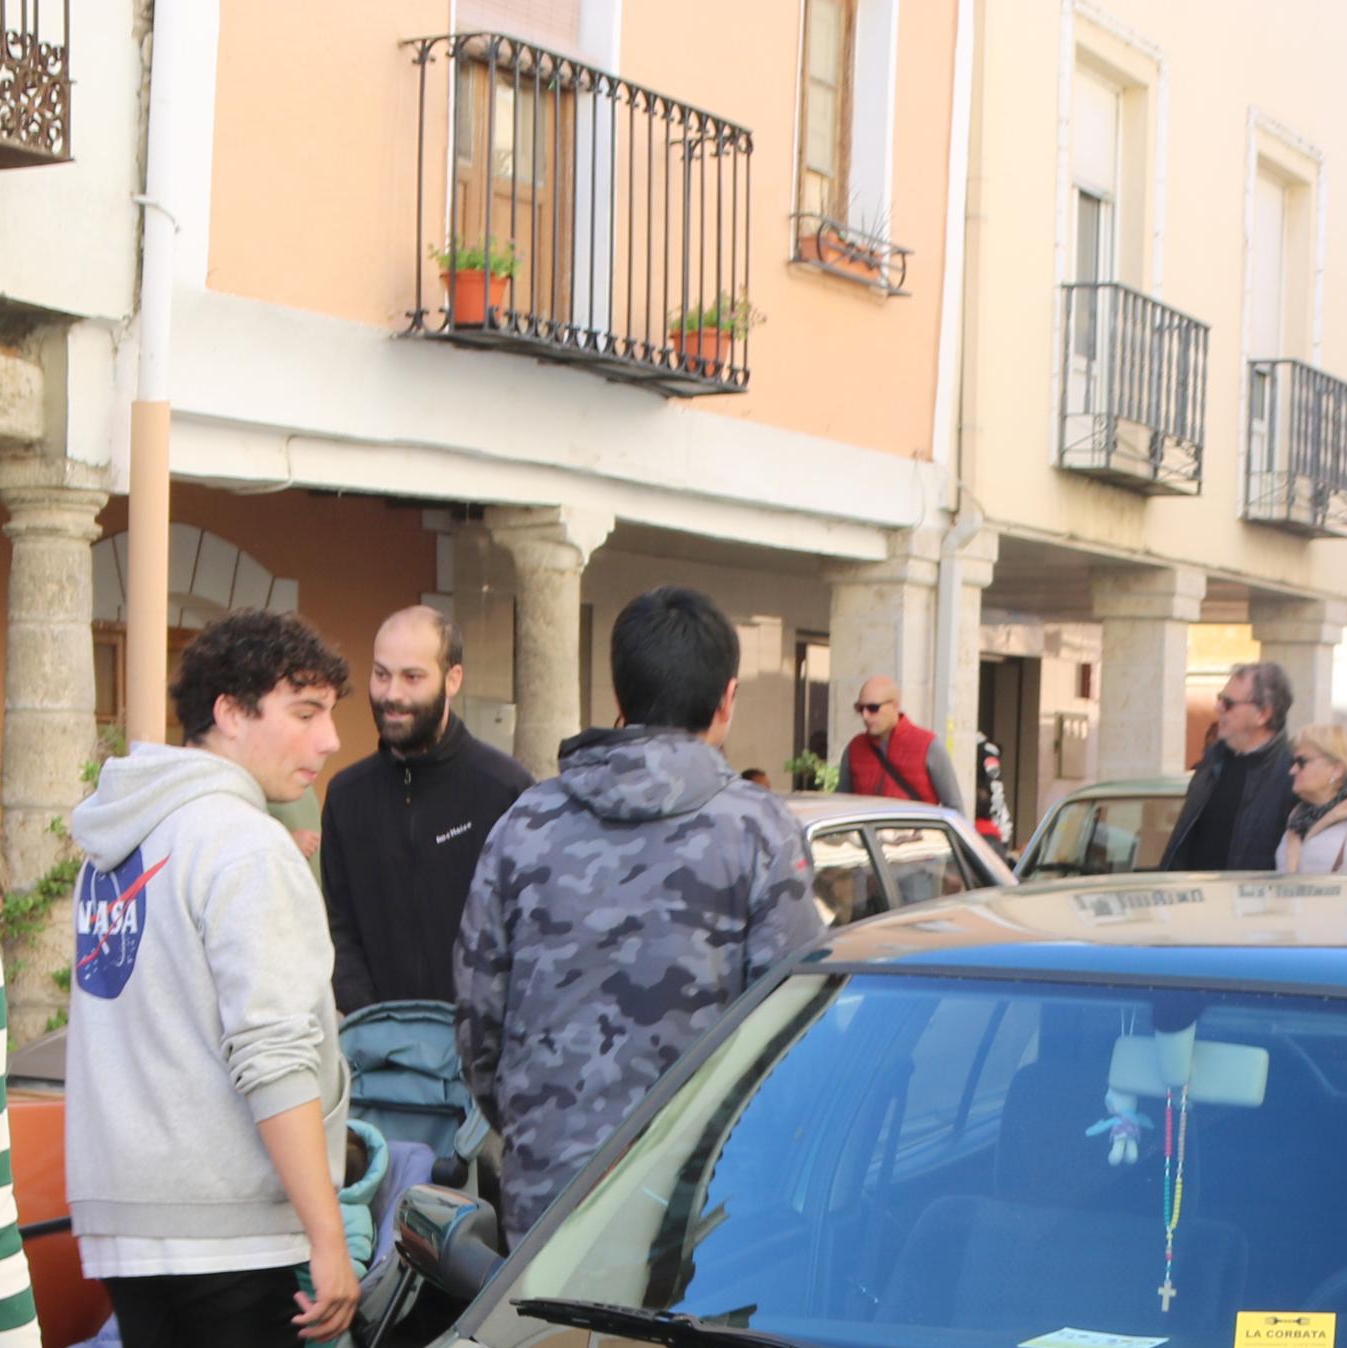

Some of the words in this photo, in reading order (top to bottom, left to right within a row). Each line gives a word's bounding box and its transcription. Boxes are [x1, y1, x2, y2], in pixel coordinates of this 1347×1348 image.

[77, 900, 138, 935] NASA
[1245, 1330, 1261, 1338] LA
[1266, 1330, 1326, 1338] CORBATA
